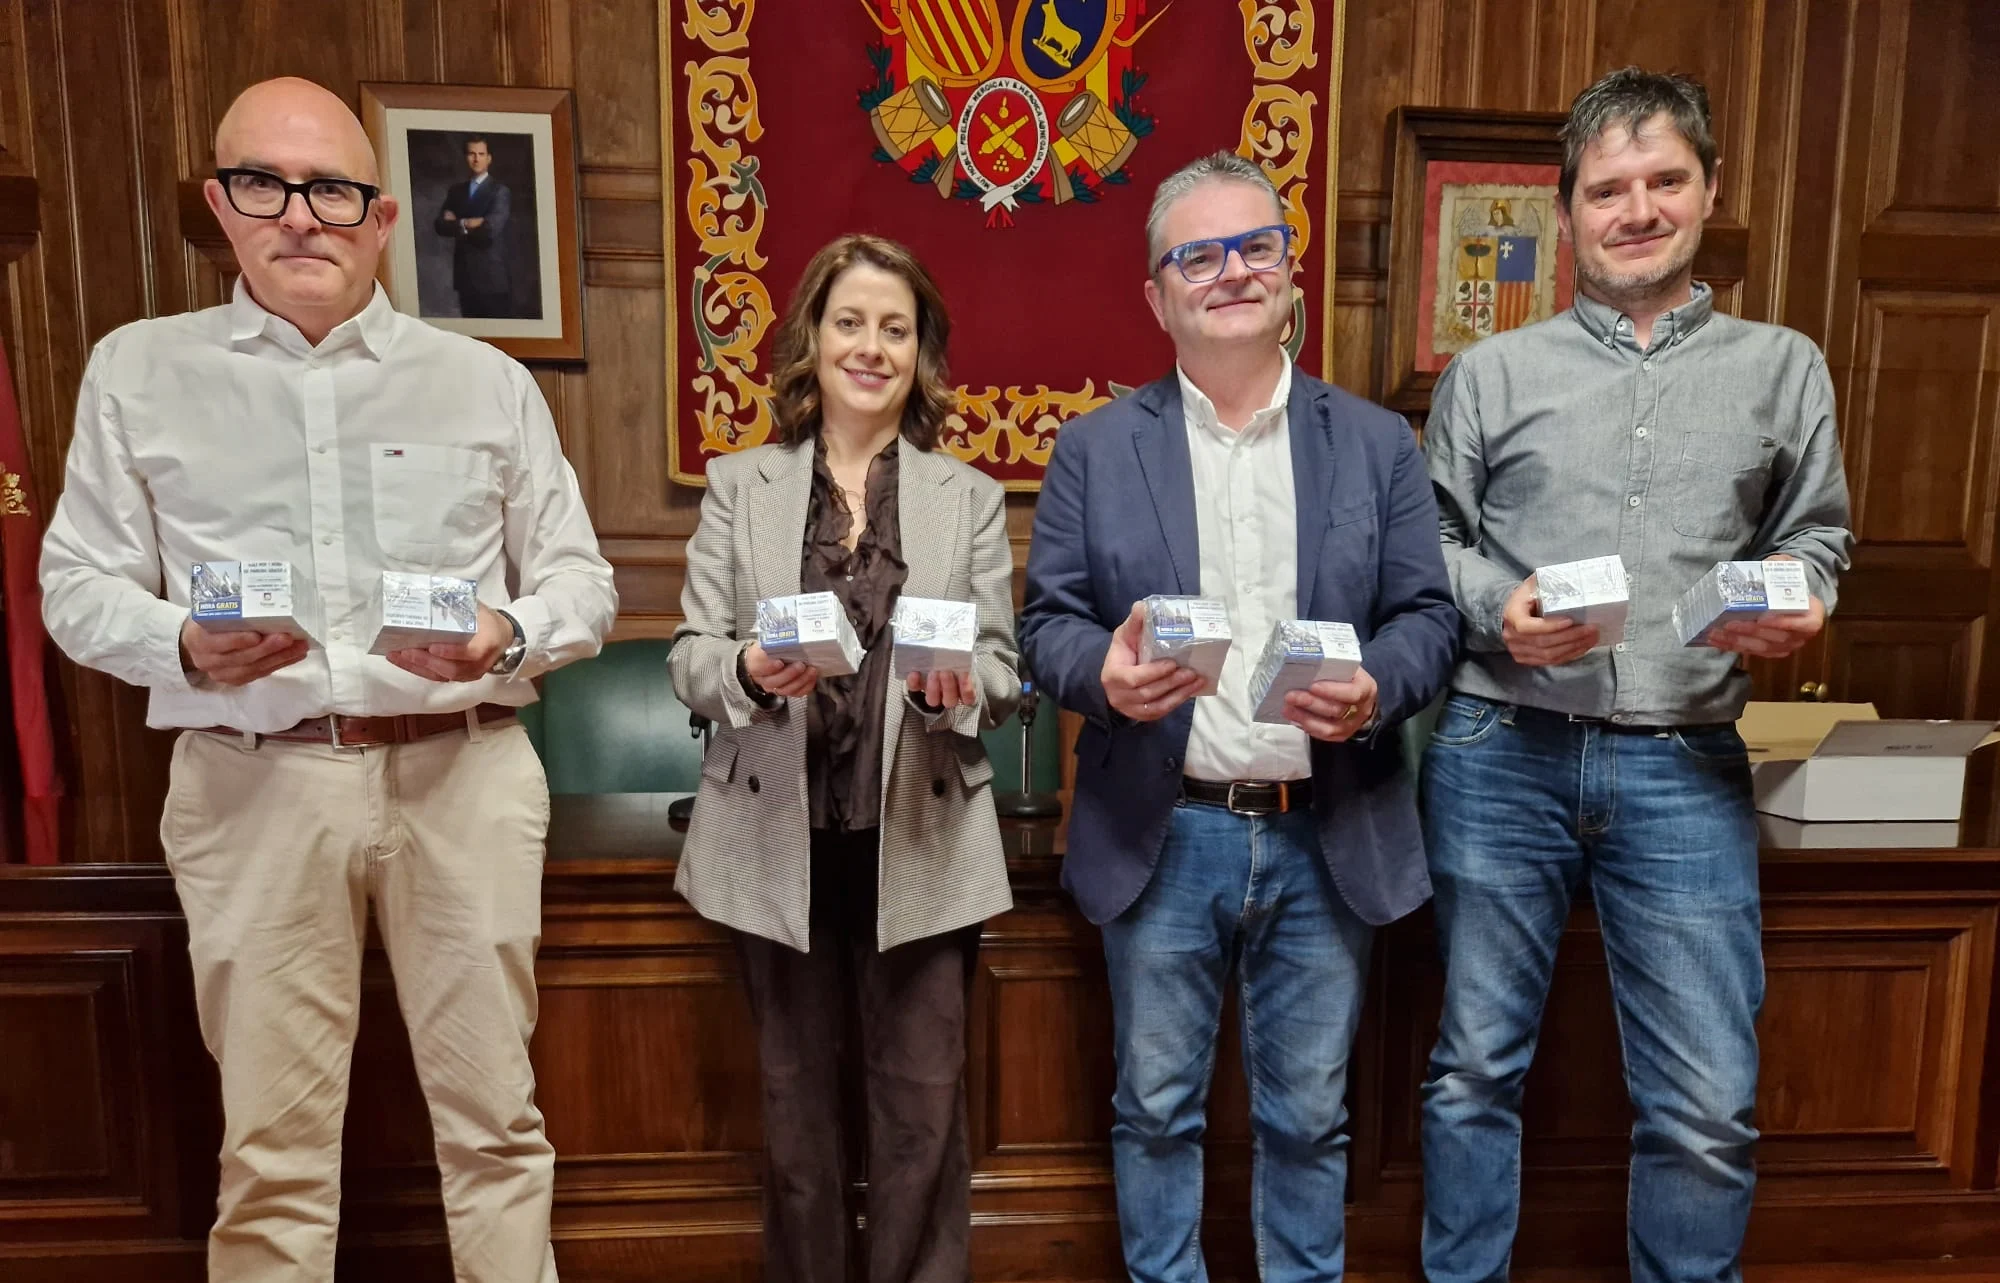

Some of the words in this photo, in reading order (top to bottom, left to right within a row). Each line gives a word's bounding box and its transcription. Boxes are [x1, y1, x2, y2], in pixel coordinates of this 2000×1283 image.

[972, 80, 1003, 102] HEROICA
[976, 175, 990, 190] MUY
[193, 565, 201, 575] P
[216, 601, 239, 609] GRATIS
